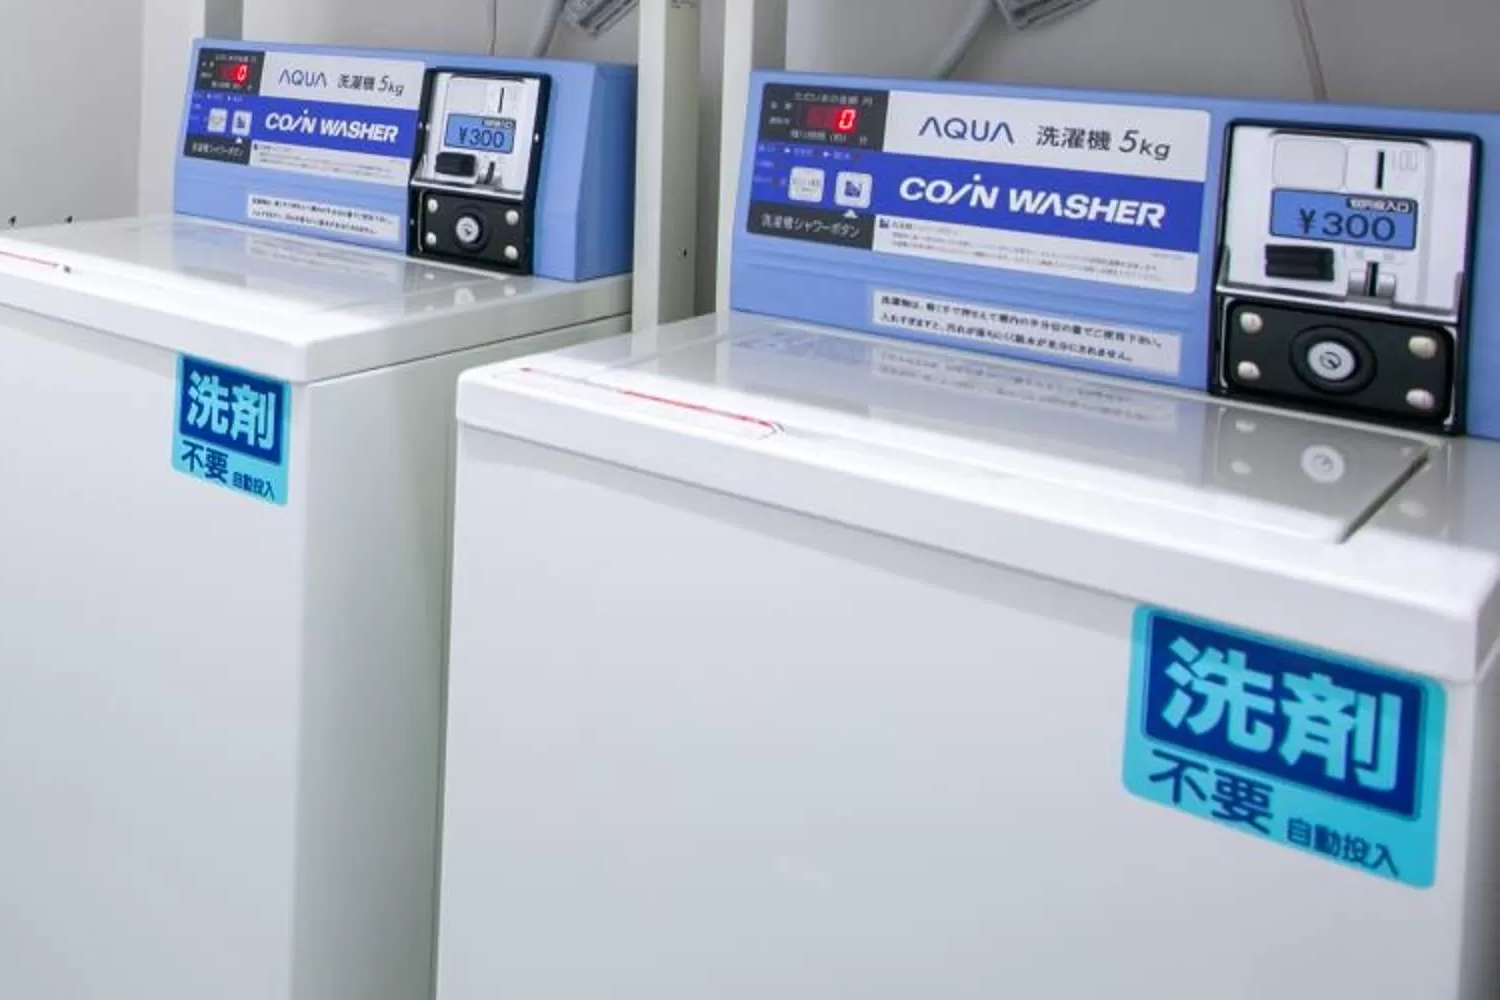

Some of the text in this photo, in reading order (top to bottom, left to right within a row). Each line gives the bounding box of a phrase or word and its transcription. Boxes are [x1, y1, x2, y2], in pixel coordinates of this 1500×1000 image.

[236, 64, 248, 82] 0
[277, 68, 328, 89] AQUA
[337, 73, 375, 92] 洗濯機
[265, 108, 399, 143] COIN WASHER
[838, 108, 857, 130] 0
[918, 116, 1015, 145] AQUA
[1036, 124, 1112, 151] 洗濯機
[457, 125, 505, 149] ¥300
[899, 174, 1167, 229] COIN WASHER
[1299, 207, 1396, 242] ¥300
[187, 370, 276, 450] 洗剤
[181, 439, 229, 484] 不要
[1161, 636, 1403, 792] 洗剤
[1149, 748, 1399, 876] 不要 自動投入
